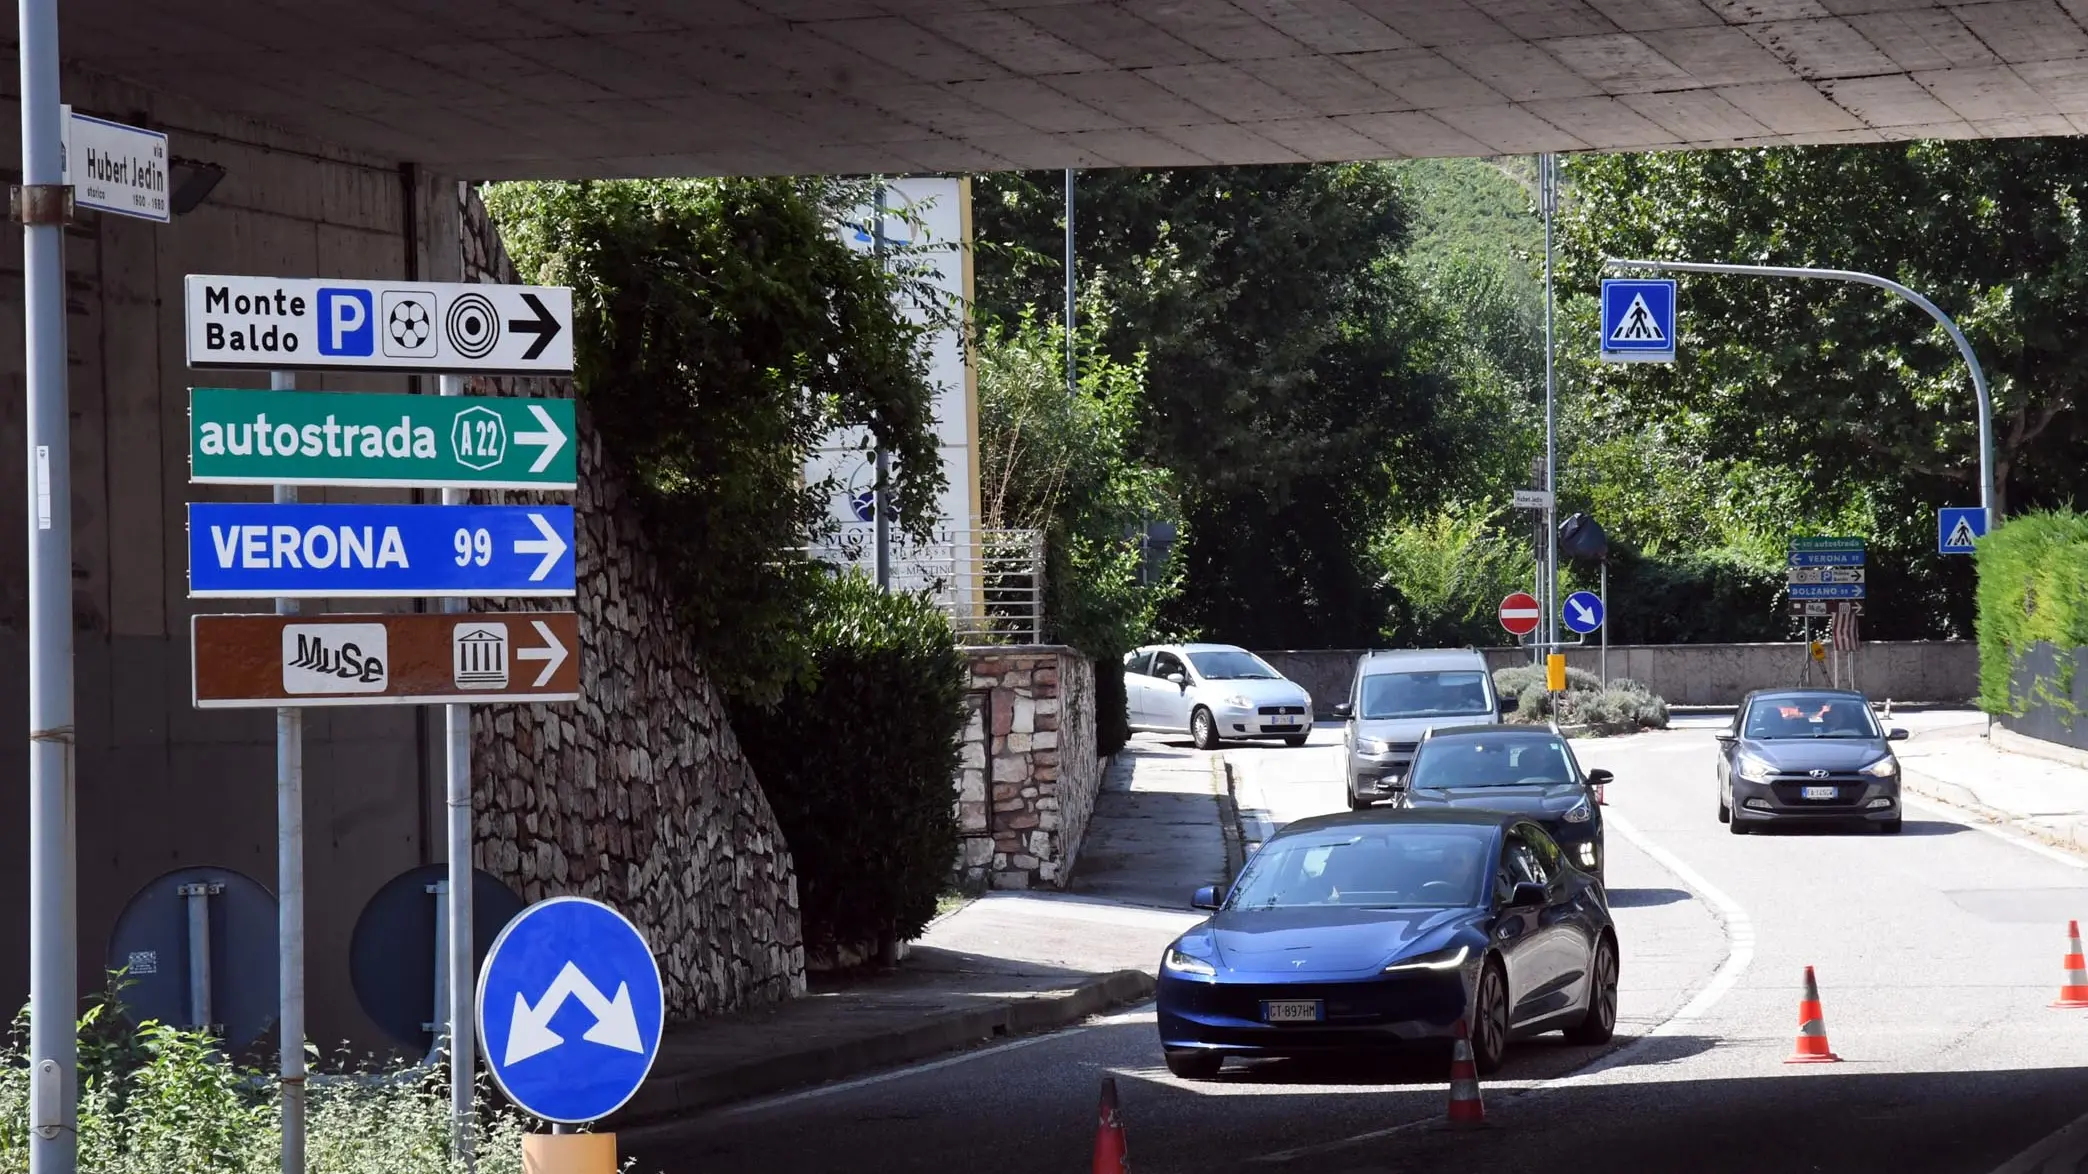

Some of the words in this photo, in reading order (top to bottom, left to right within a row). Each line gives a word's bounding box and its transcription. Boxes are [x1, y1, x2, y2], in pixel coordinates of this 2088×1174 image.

[153, 141, 163, 158] via
[87, 147, 128, 185] Hubert
[131, 156, 164, 192] Jedin
[205, 286, 306, 316] Monte
[206, 322, 299, 352] Baldo
[330, 294, 366, 350] P
[199, 412, 437, 459] autostrada
[210, 524, 410, 569] VERONA
[453, 527, 493, 568] 99
[1807, 555, 1848, 563] VERONA
[1792, 587, 1838, 596] BOLZANO
